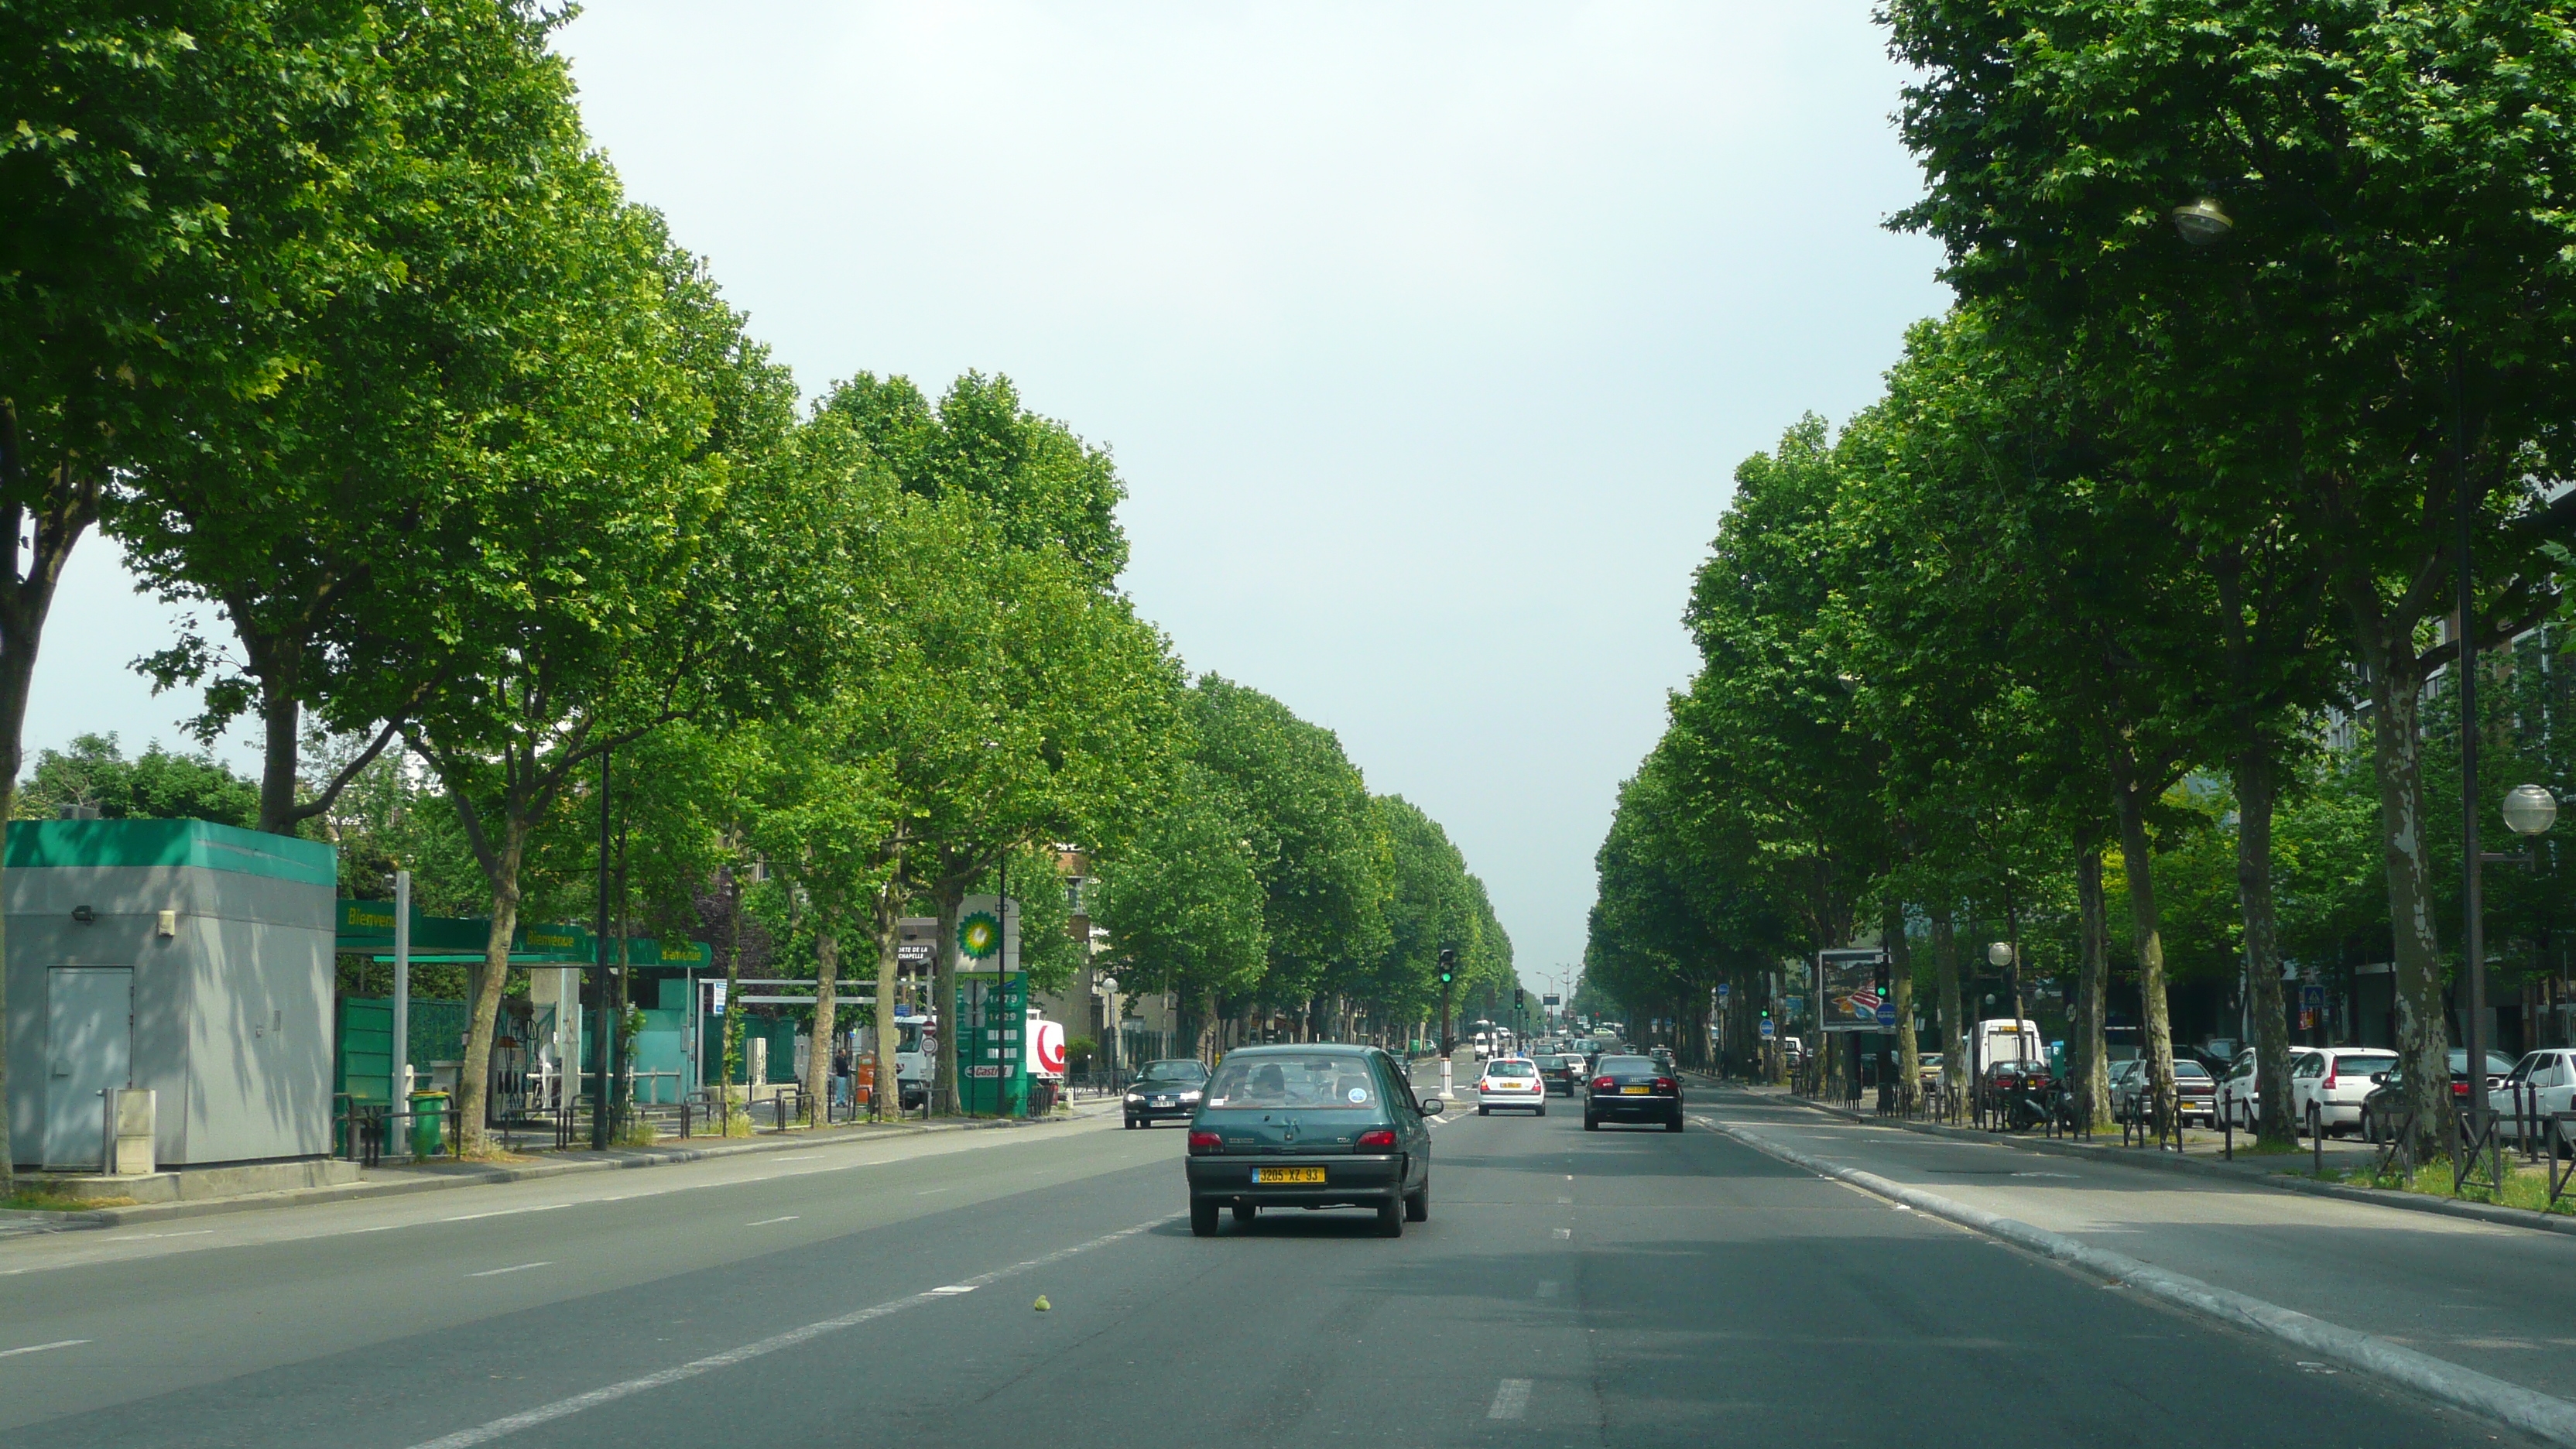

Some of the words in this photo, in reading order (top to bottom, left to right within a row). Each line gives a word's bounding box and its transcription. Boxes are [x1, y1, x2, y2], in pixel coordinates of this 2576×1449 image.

[348, 907, 396, 928] Bienvenu
[527, 930, 574, 947] Bienvenue
[662, 949, 702, 961] Bienvnue
[975, 1067, 1008, 1077] Castrl
[1261, 1169, 1283, 1181] 3205
[1289, 1170, 1300, 1181] XZ
[1307, 1169, 1318, 1181] 93
